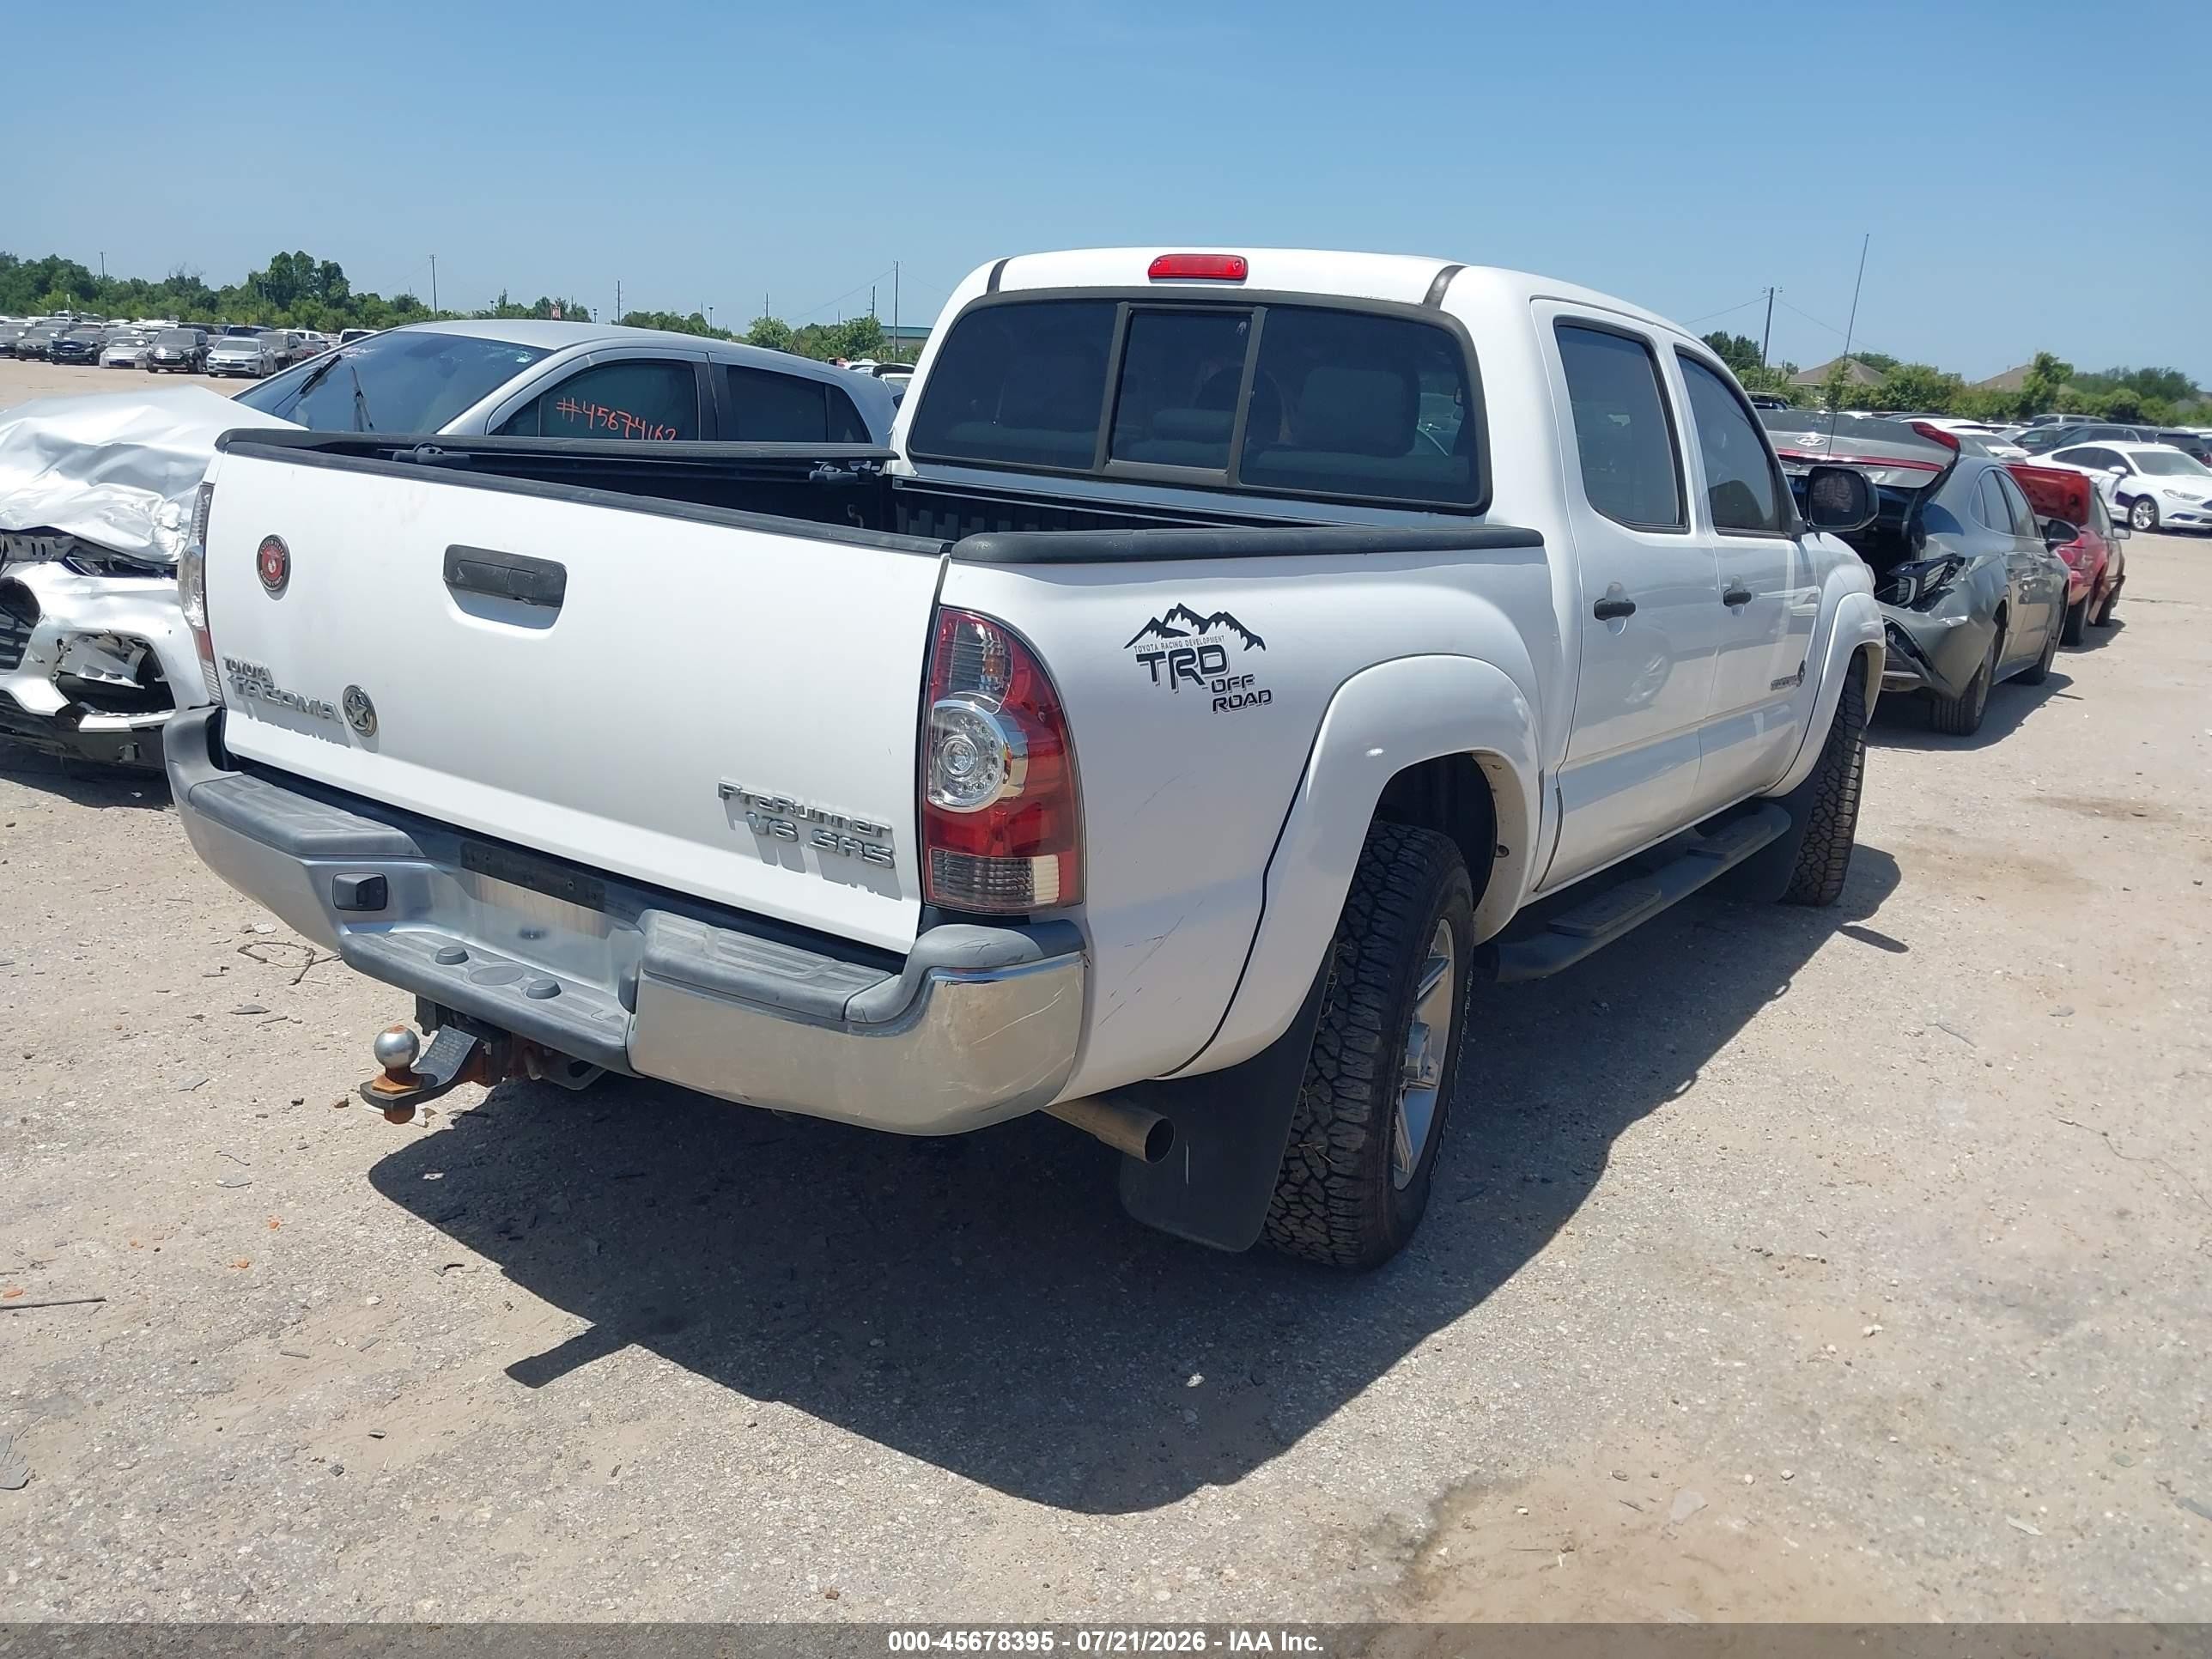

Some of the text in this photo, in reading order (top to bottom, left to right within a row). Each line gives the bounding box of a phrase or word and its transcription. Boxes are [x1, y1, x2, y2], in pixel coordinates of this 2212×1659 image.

[1133, 635, 1225, 653] TOYOTA RACING DEVELOPMENT
[222, 657, 275, 688] TOYOTA
[1136, 644, 1229, 692] TRD
[1211, 673, 1255, 695] OFF
[227, 674, 343, 724] TACOMA
[1212, 690, 1273, 714] ROAD
[717, 781, 893, 838] PreRunner
[745, 811, 895, 869] V6 SR5
